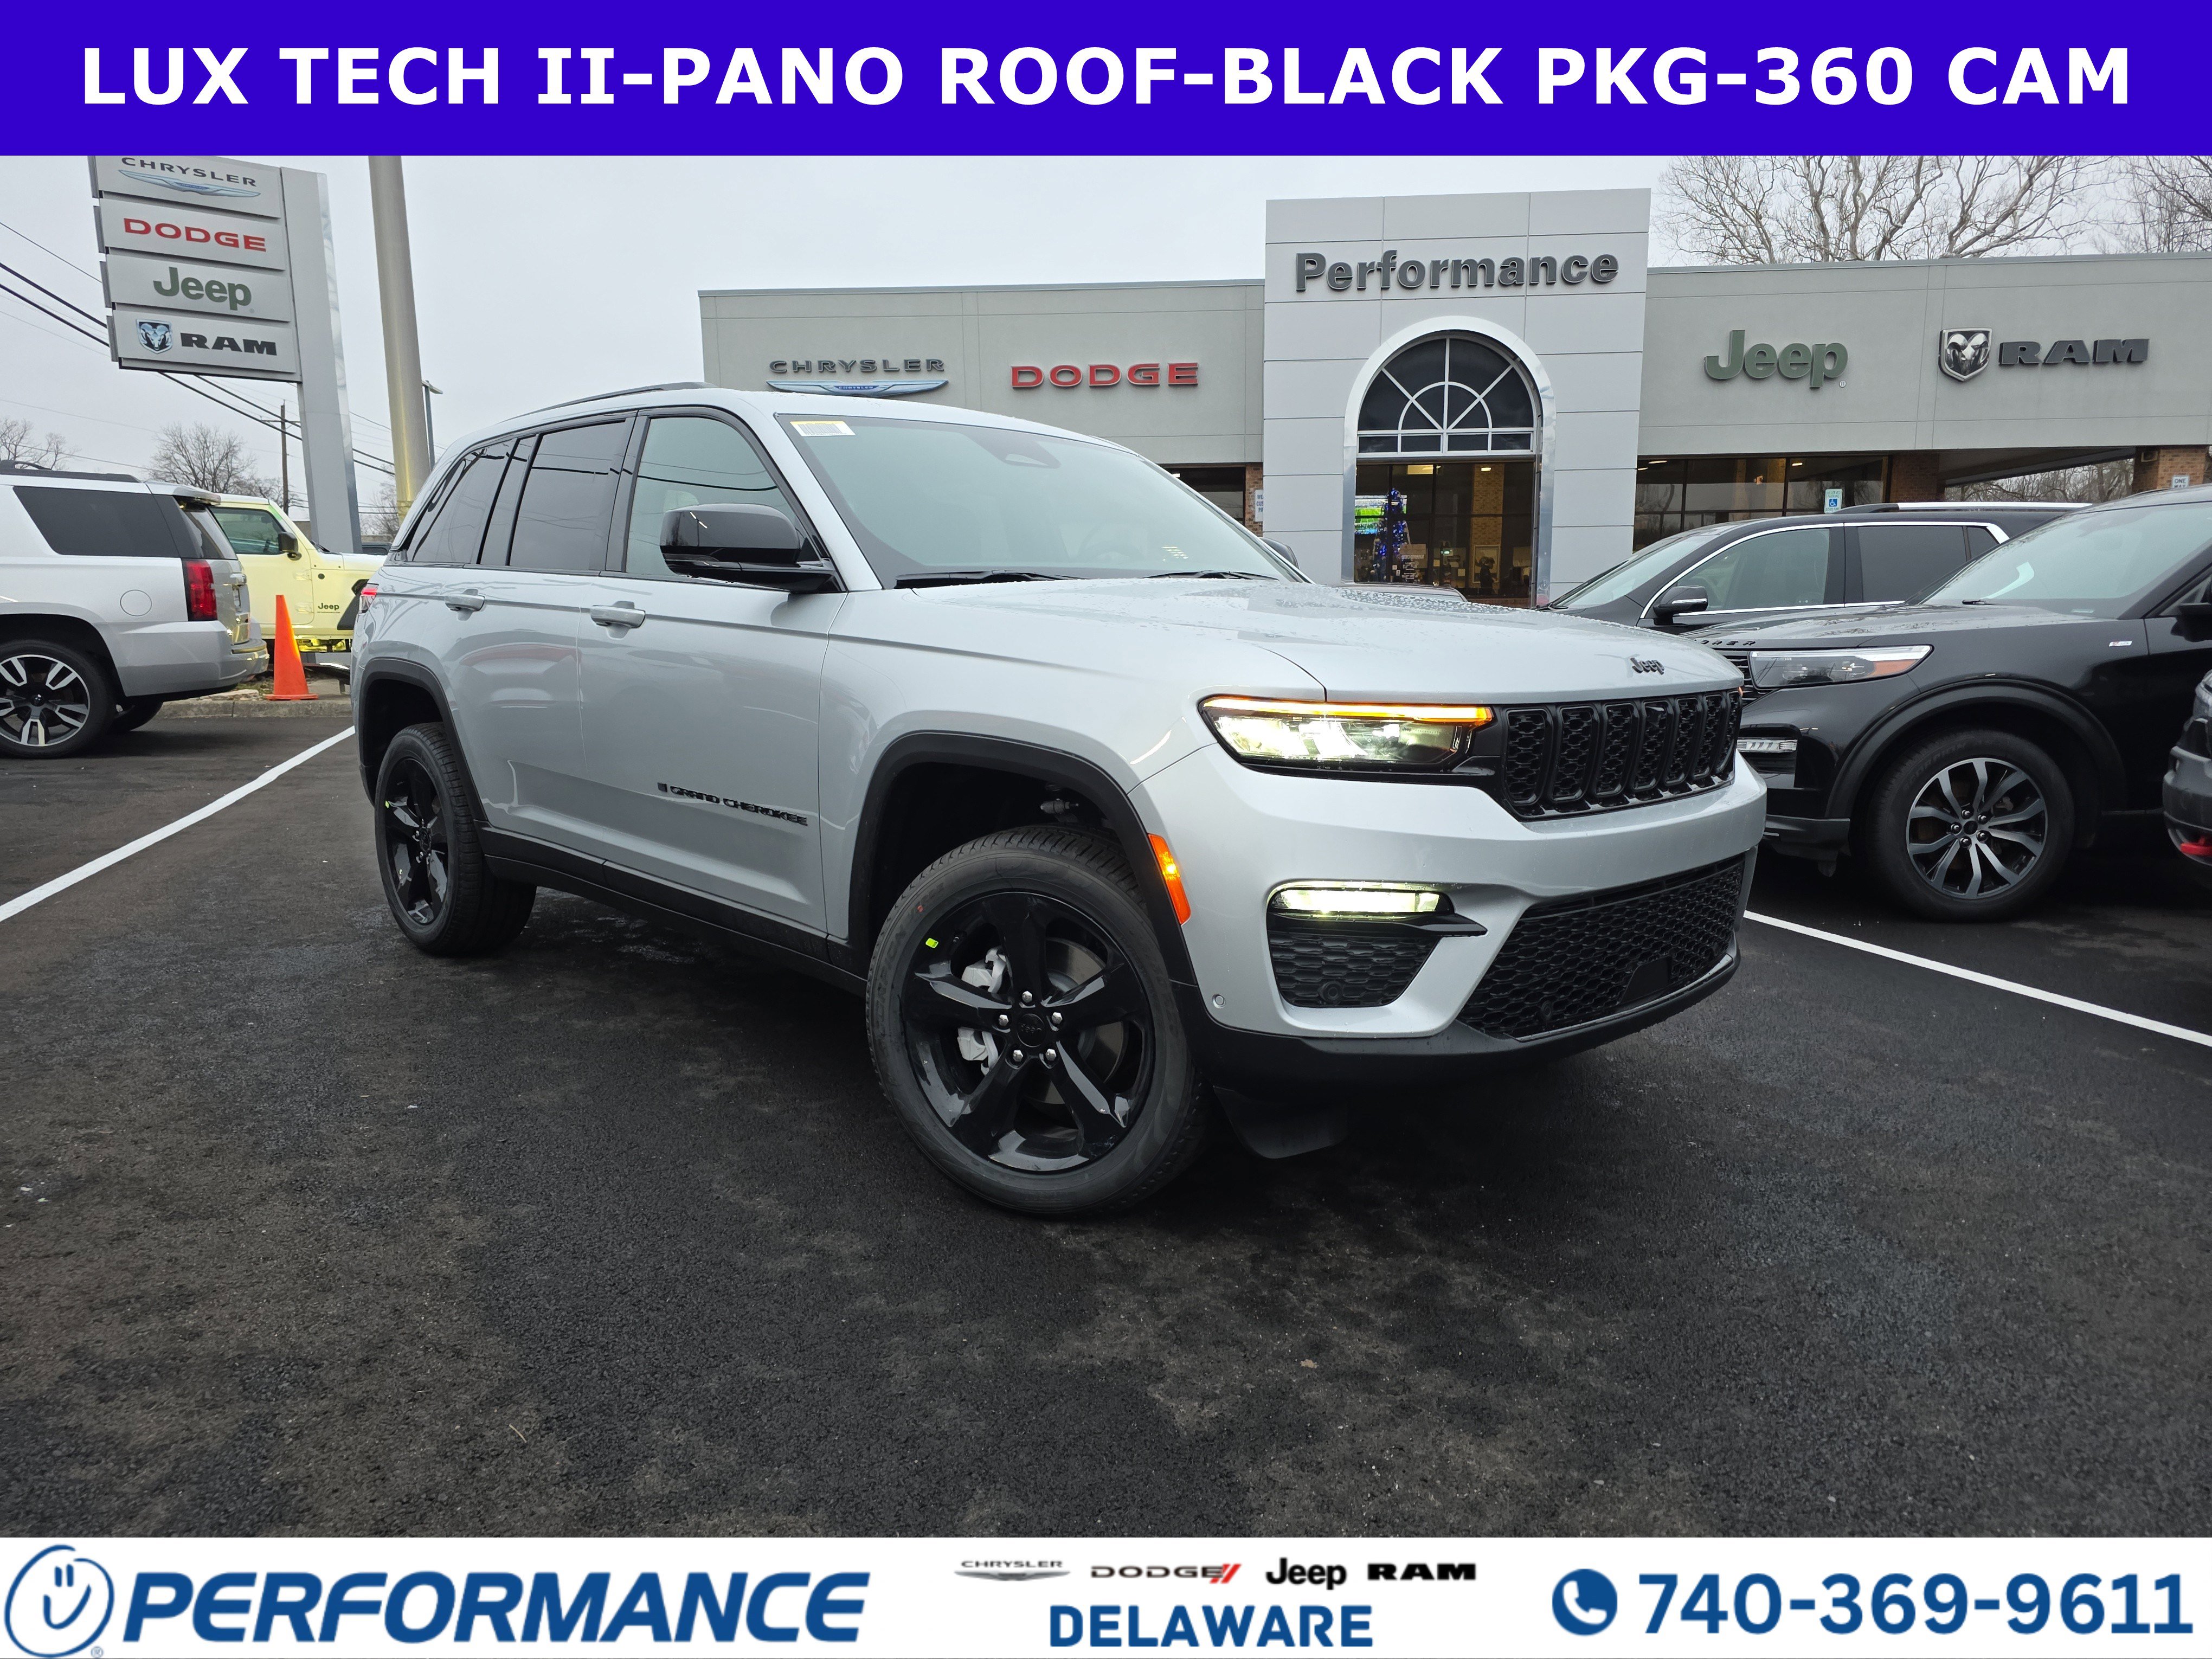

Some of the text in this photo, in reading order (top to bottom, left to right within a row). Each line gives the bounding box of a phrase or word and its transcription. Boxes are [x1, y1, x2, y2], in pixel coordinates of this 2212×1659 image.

[121, 157, 257, 187] CHRYSLER
[124, 217, 266, 252] DODGE
[1296, 250, 1619, 292] Performance
[153, 267, 252, 311] Jeep
[181, 332, 278, 356] RAM
[1998, 338, 2150, 365] RAM
[769, 358, 944, 374] CHRYSLER
[1703, 330, 1849, 388] Jeep
[1010, 362, 1199, 388] DODGE
[318, 602, 339, 611] Jeep
[1630, 657, 1665, 675] Jeep
[723, 798, 808, 826] CHEROKEE
